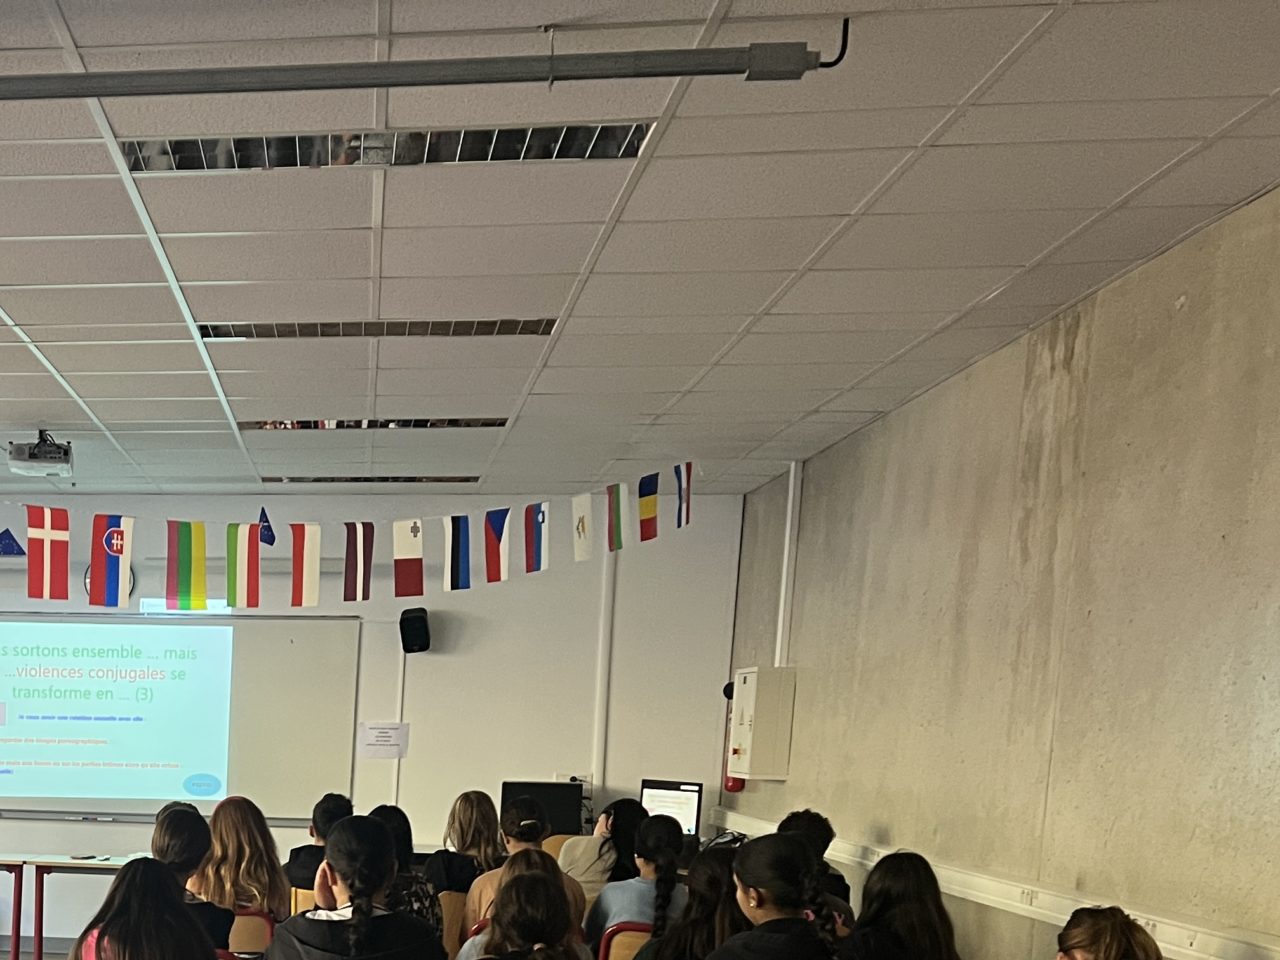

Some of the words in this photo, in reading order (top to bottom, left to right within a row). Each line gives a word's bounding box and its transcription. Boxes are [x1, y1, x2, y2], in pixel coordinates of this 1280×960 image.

[13, 644, 68, 658] sortons
[72, 644, 143, 659] ensemble
[164, 646, 198, 660] mais
[88, 665, 166, 683] conjugales
[170, 670, 186, 680] se
[12, 685, 91, 700] transforme
[96, 689, 114, 700] en
[135, 687, 154, 703] (3)
